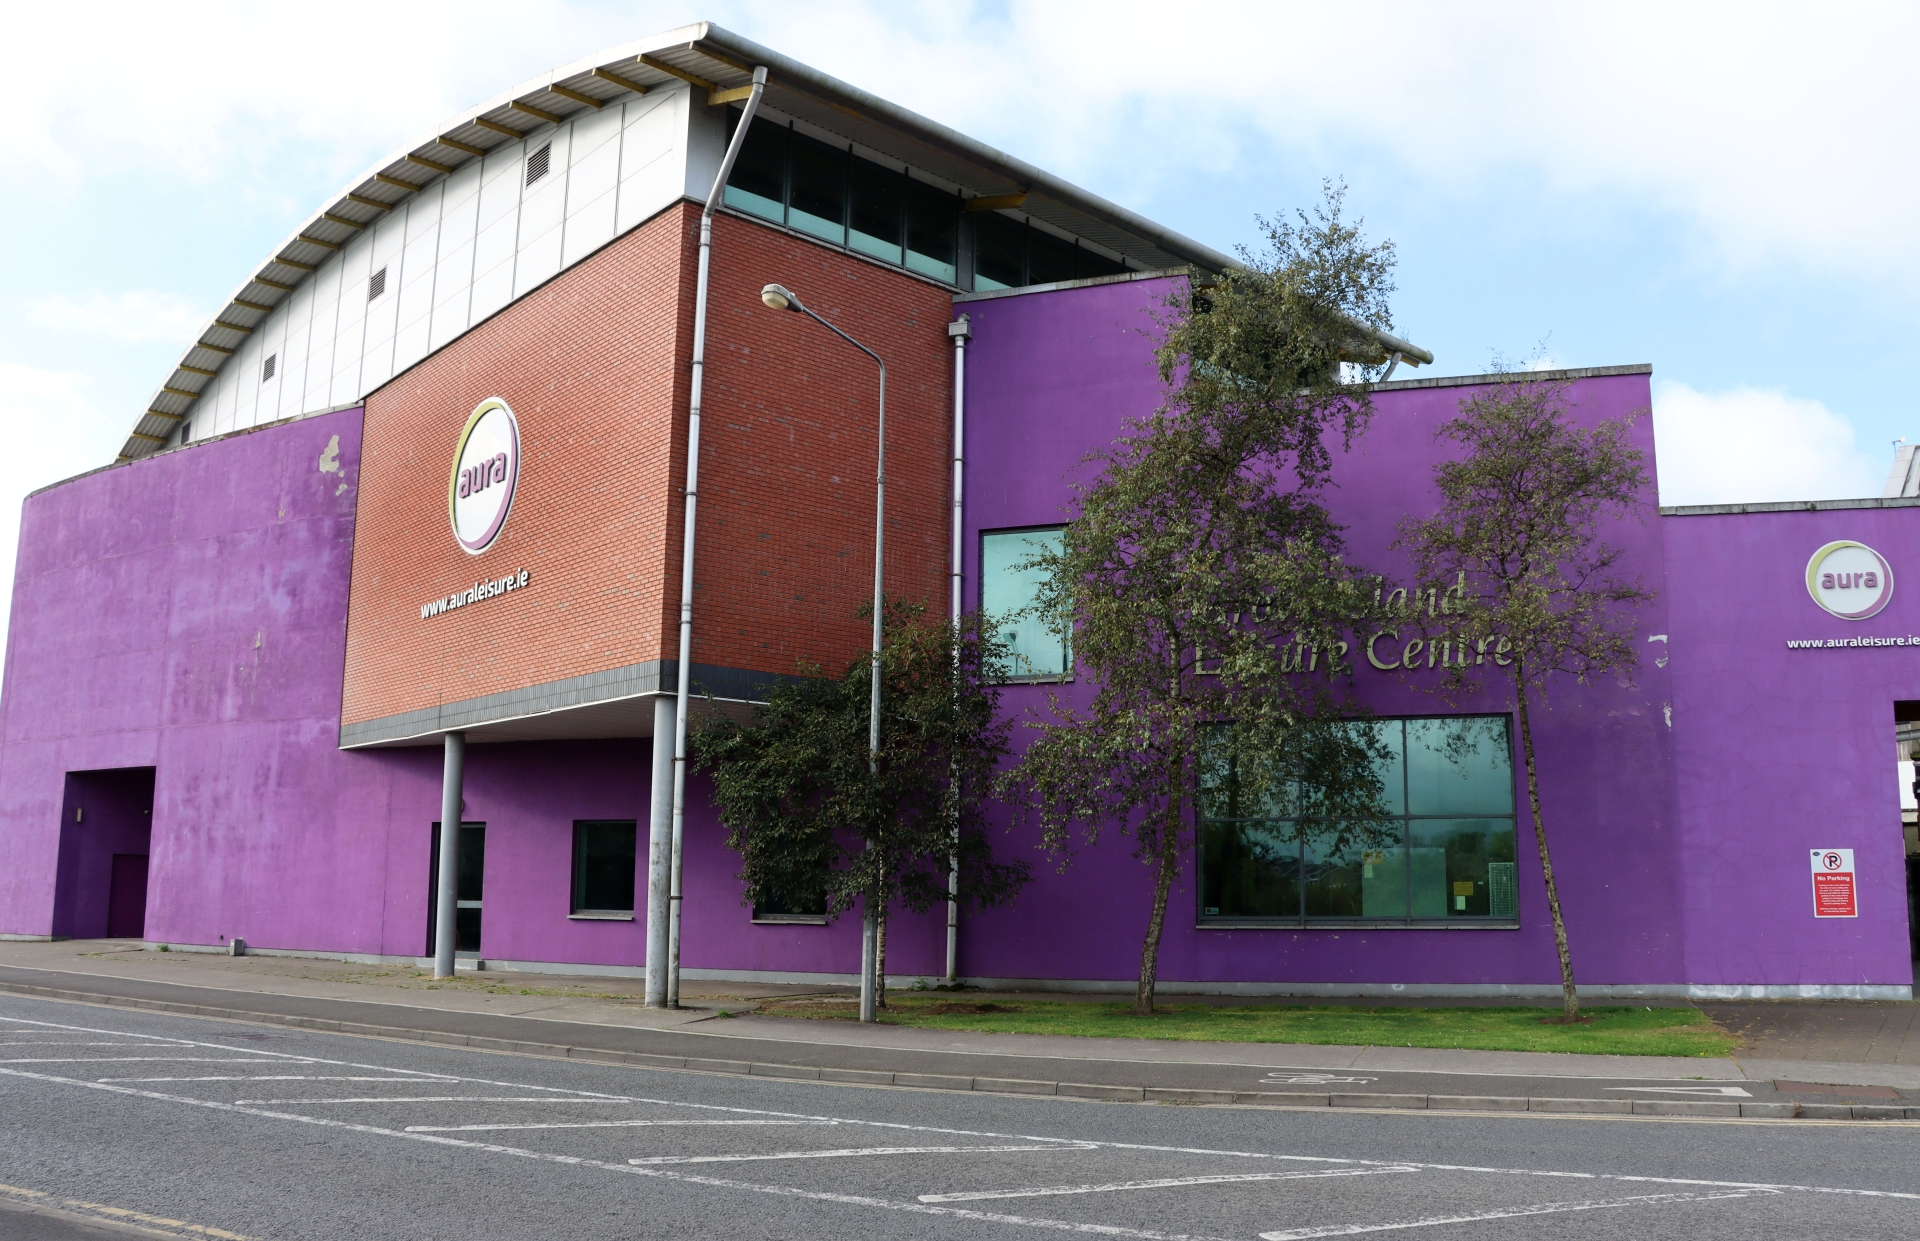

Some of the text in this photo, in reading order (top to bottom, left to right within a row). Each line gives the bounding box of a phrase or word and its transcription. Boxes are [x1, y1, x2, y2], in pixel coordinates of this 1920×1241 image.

[459, 452, 506, 498] aura
[420, 567, 529, 619] www.auraleisure.ie
[1821, 571, 1878, 589] aura
[1367, 629, 1512, 670] Centre
[1787, 635, 1920, 648] www.auraleisure.ie
